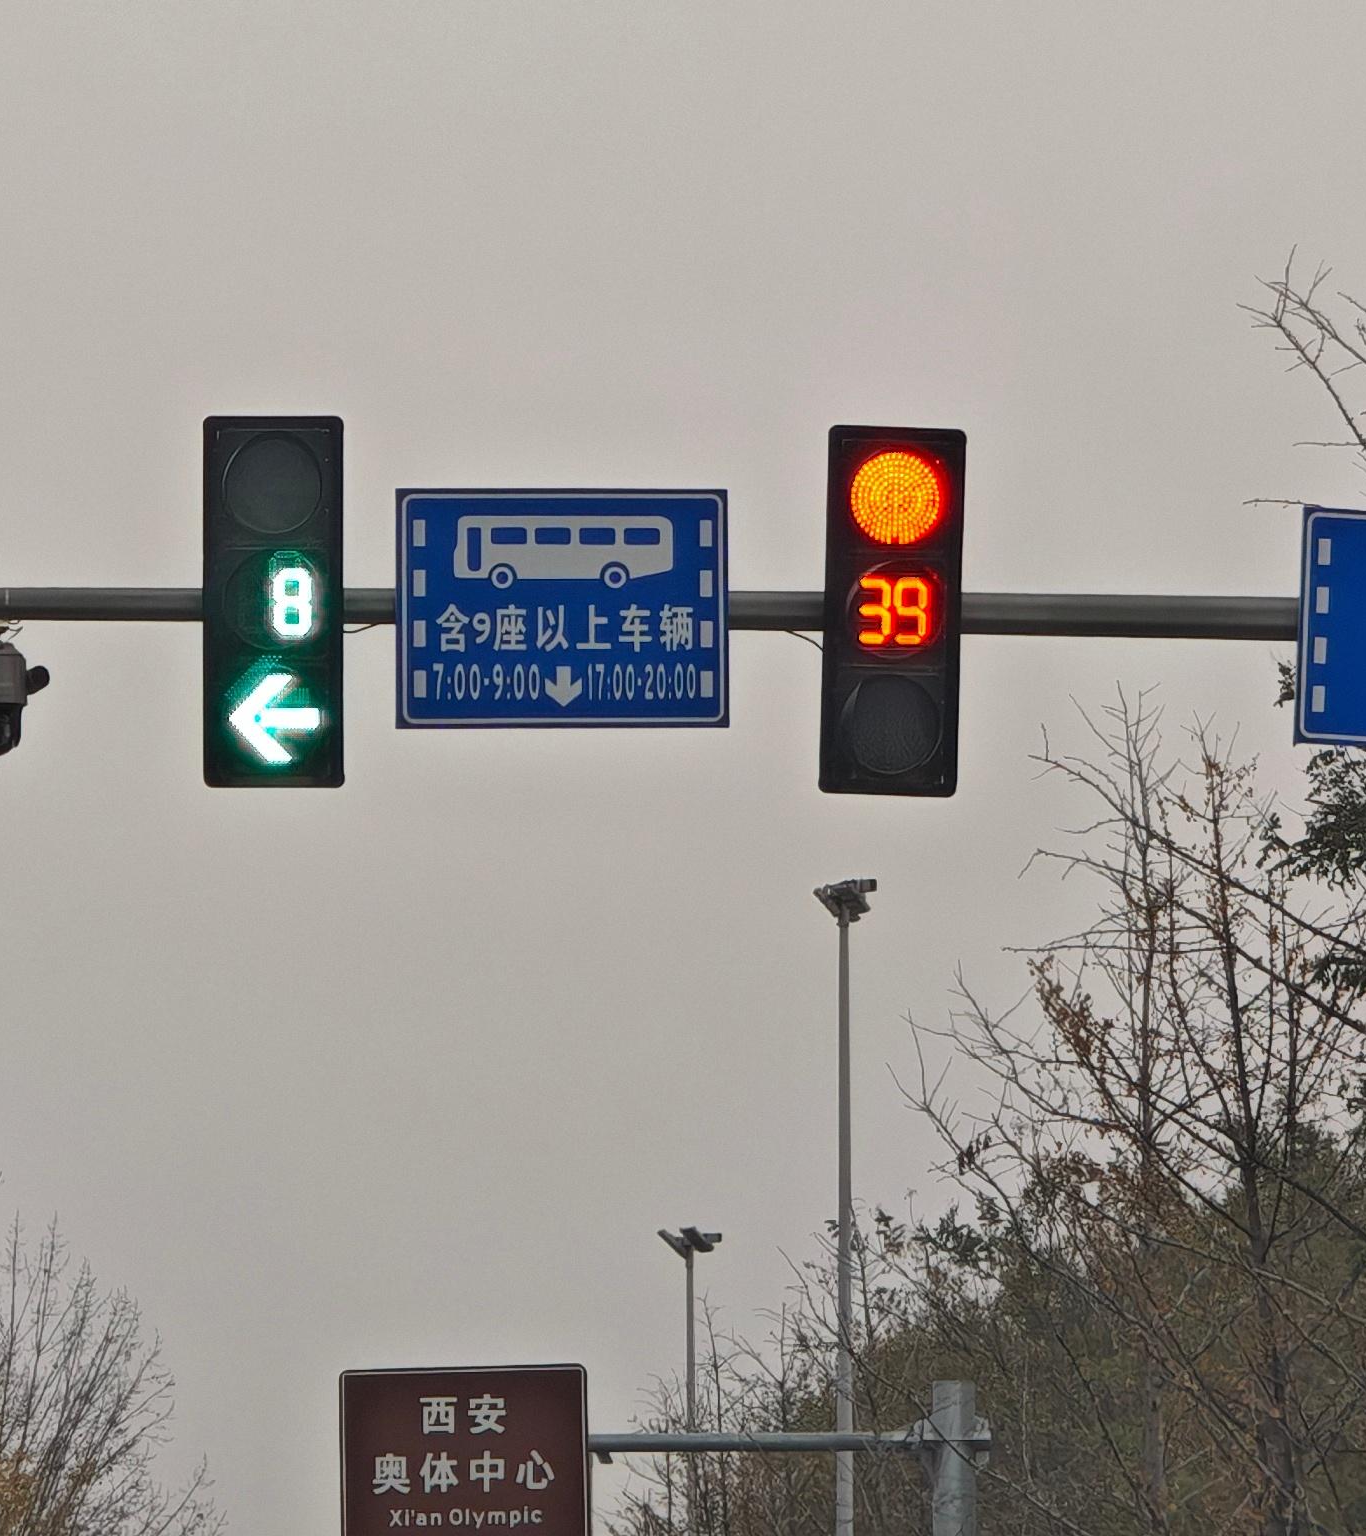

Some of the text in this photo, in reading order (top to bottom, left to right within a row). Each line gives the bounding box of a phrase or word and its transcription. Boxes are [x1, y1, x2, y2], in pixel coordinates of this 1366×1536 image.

[270, 563, 314, 641] 8
[857, 576, 930, 646] 39
[436, 603, 694, 652] 含9座以上车辆
[432, 663, 540, 702] 7:00-9:00
[588, 663, 696, 702] 17:00-20:00
[419, 1393, 507, 1434] 西安
[372, 1449, 555, 1495] 奥体中心
[449, 1506, 543, 1529] Olympic
